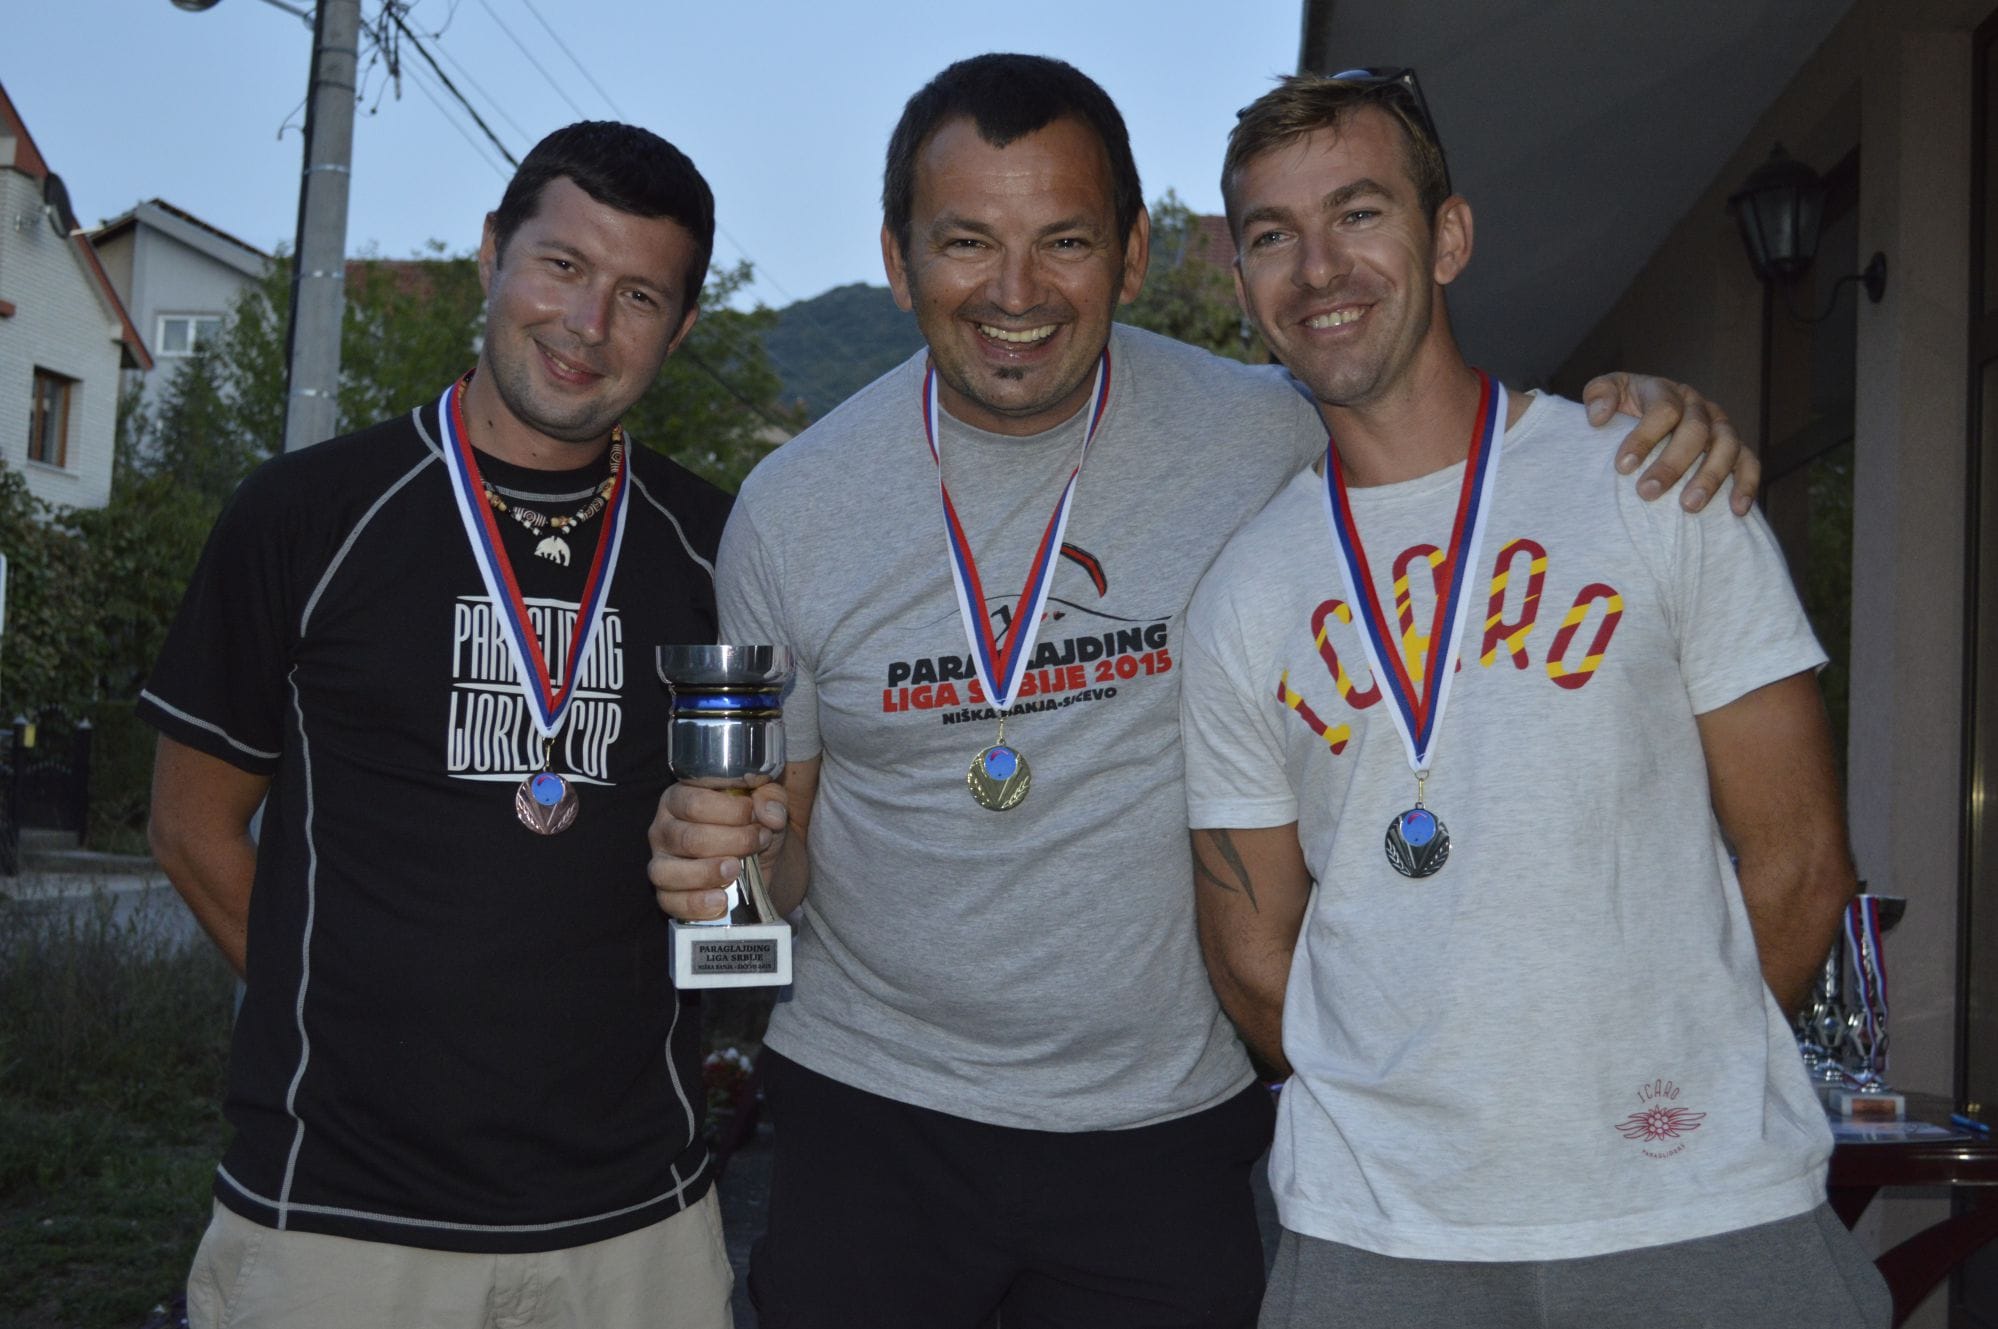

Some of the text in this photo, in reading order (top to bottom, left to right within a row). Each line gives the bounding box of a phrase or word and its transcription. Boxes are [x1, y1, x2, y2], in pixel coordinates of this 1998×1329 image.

[453, 603, 623, 690] PARLING
[888, 623, 1168, 687] PARAJDING
[1277, 538, 1624, 755] ICARO
[883, 648, 1172, 712] LIGA SBIJE 2015
[448, 691, 622, 779] WORLD CUP
[942, 706, 997, 725] NIŠKA
[700, 945, 770, 953] PARAGLAJDING
[731, 953, 763, 961] SRBIJE
[1637, 1078, 1680, 1103] ICARO
